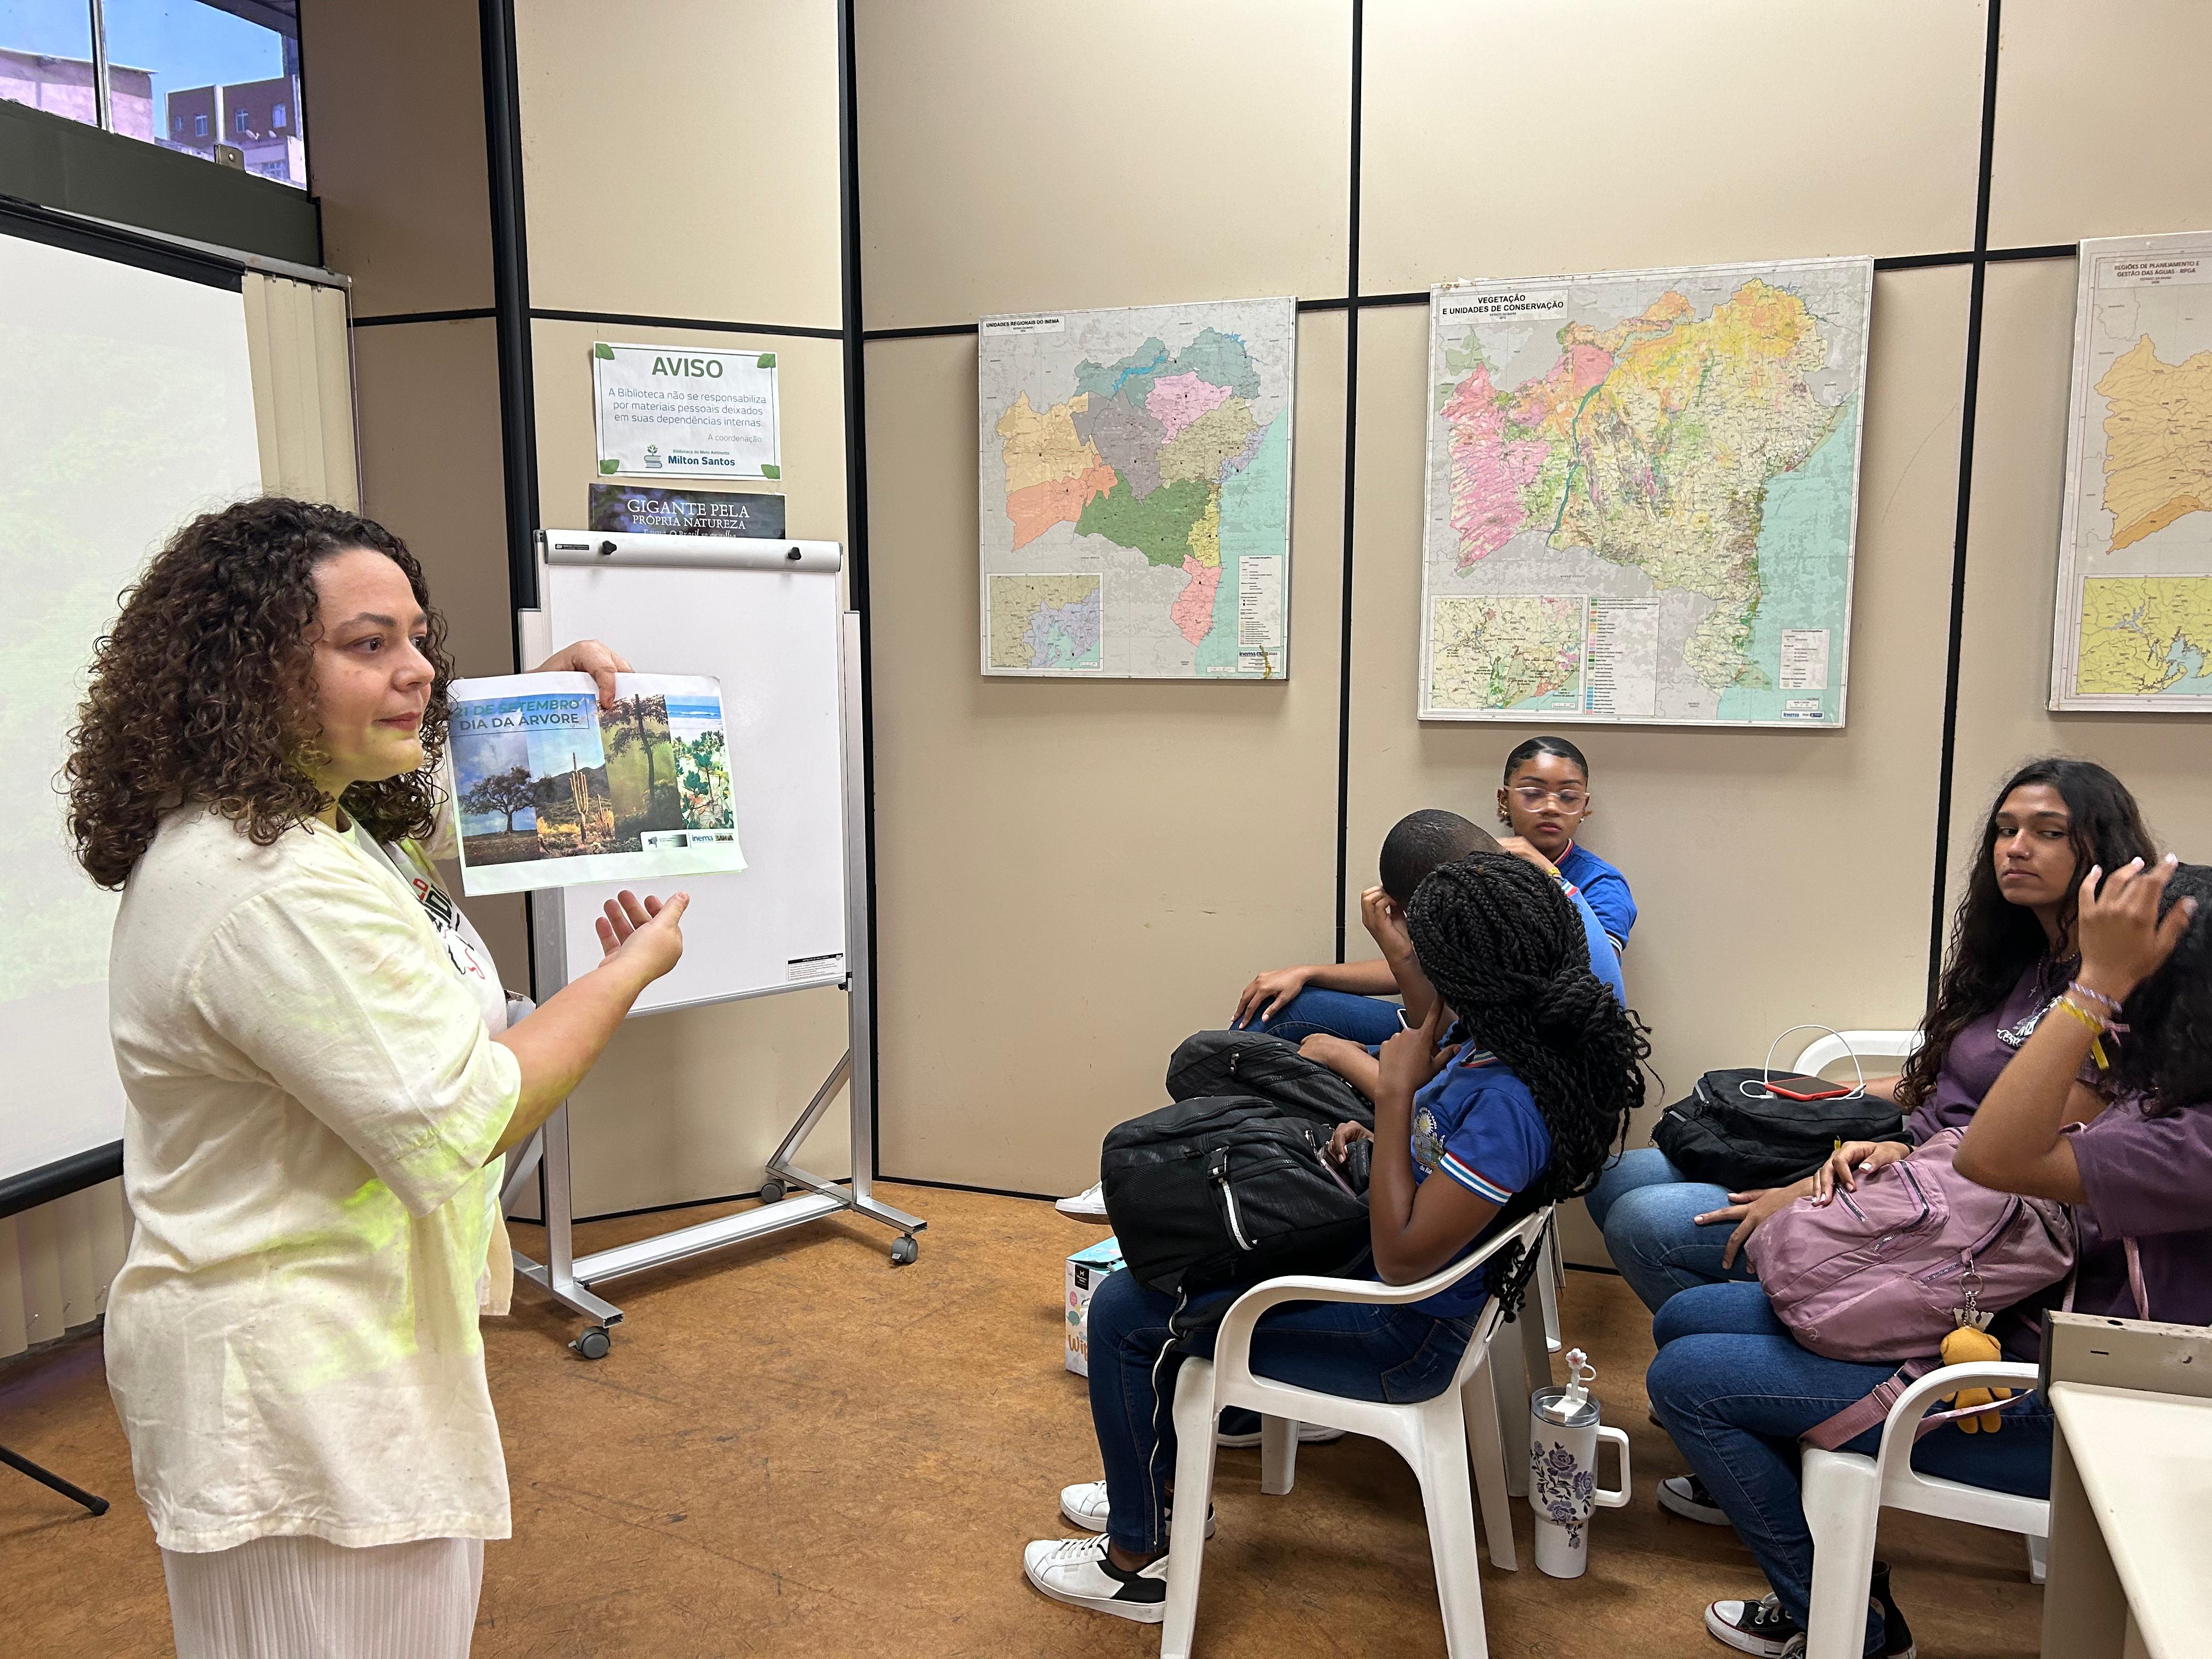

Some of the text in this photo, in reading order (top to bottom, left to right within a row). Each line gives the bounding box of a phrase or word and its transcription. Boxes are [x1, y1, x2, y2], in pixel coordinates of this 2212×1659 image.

[1478, 294, 1526, 304] VEGETAÇÃO
[1449, 306, 1489, 314] UNIDADES
[1503, 300, 1564, 312] CONSERVAÇÃO
[652, 357, 723, 378] AVISO
[608, 388, 615, 397] A
[618, 388, 664, 399] Biblioteca
[667, 391, 685, 400] não
[701, 393, 766, 404] responsabiliza
[613, 402, 763, 415] por materiais pessoais deixados
[657, 415, 721, 425] dependências
[724, 417, 764, 427] internas.
[668, 455, 736, 466] Milton Santos
[627, 499, 750, 518] GIGANTE PELA
[633, 514, 746, 529] PRÓPRIA NATUREZA
[473, 704, 494, 715] DE
[498, 699, 579, 713] SETEMBRO
[460, 713, 579, 730] DIA DA ÁRVORE
